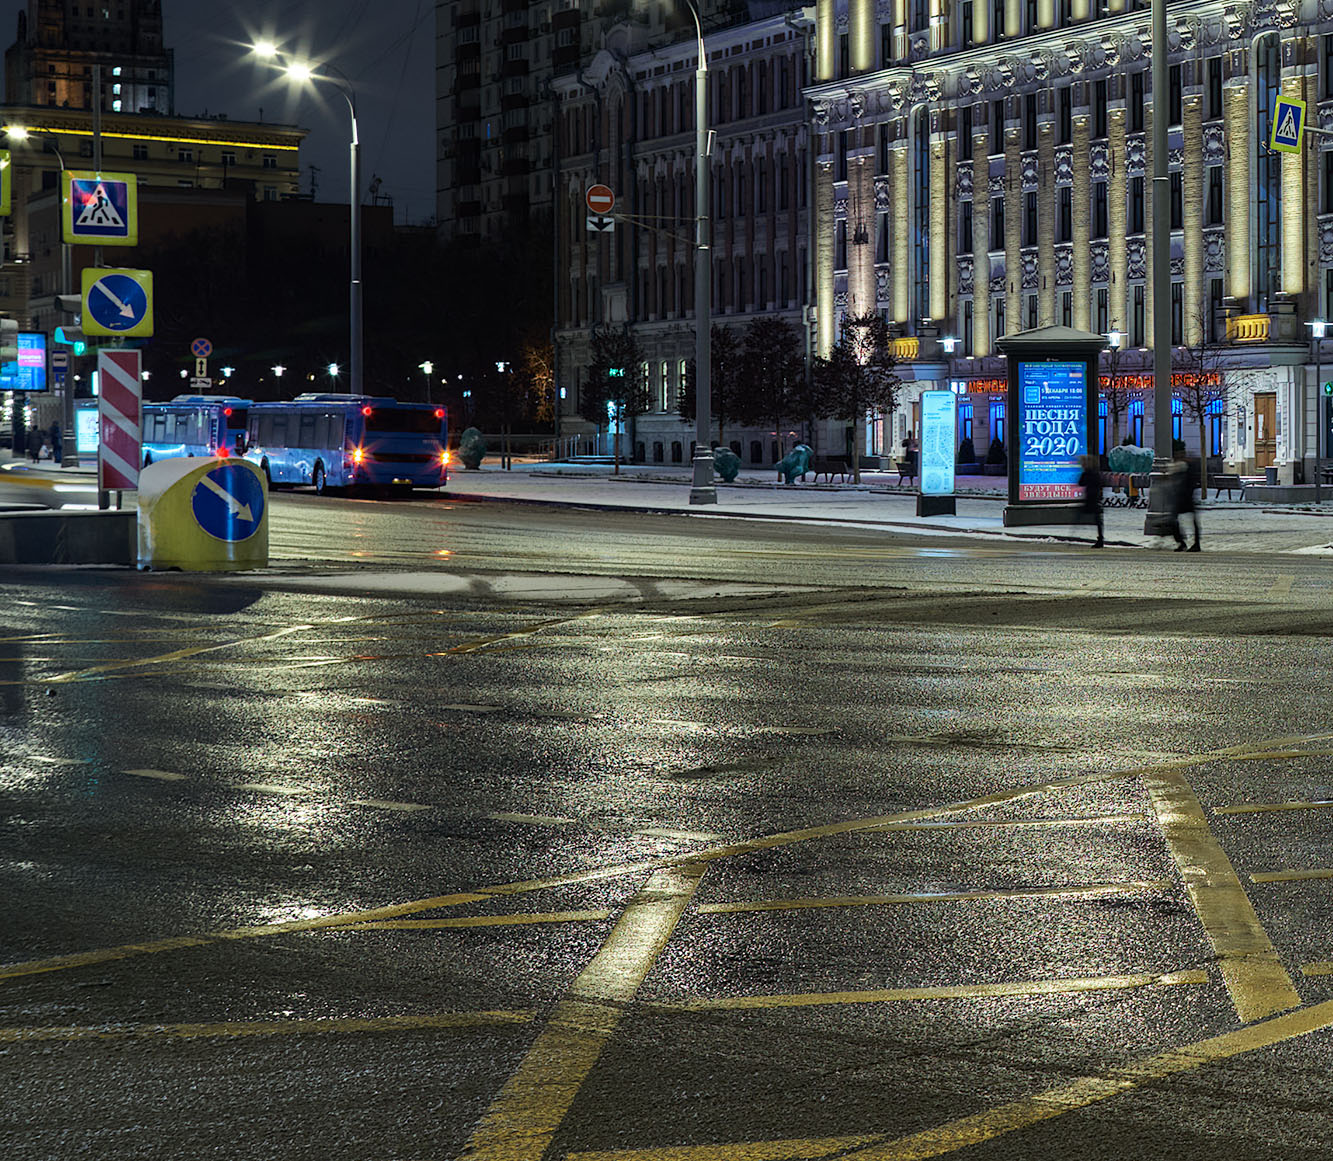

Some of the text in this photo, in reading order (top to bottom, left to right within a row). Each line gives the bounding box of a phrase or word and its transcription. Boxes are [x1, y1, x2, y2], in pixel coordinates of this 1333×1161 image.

[1025, 409, 1079, 420] ПЕСНЯ
[1025, 421, 1079, 436] ГОДА
[1025, 437, 1080, 456] 2020
